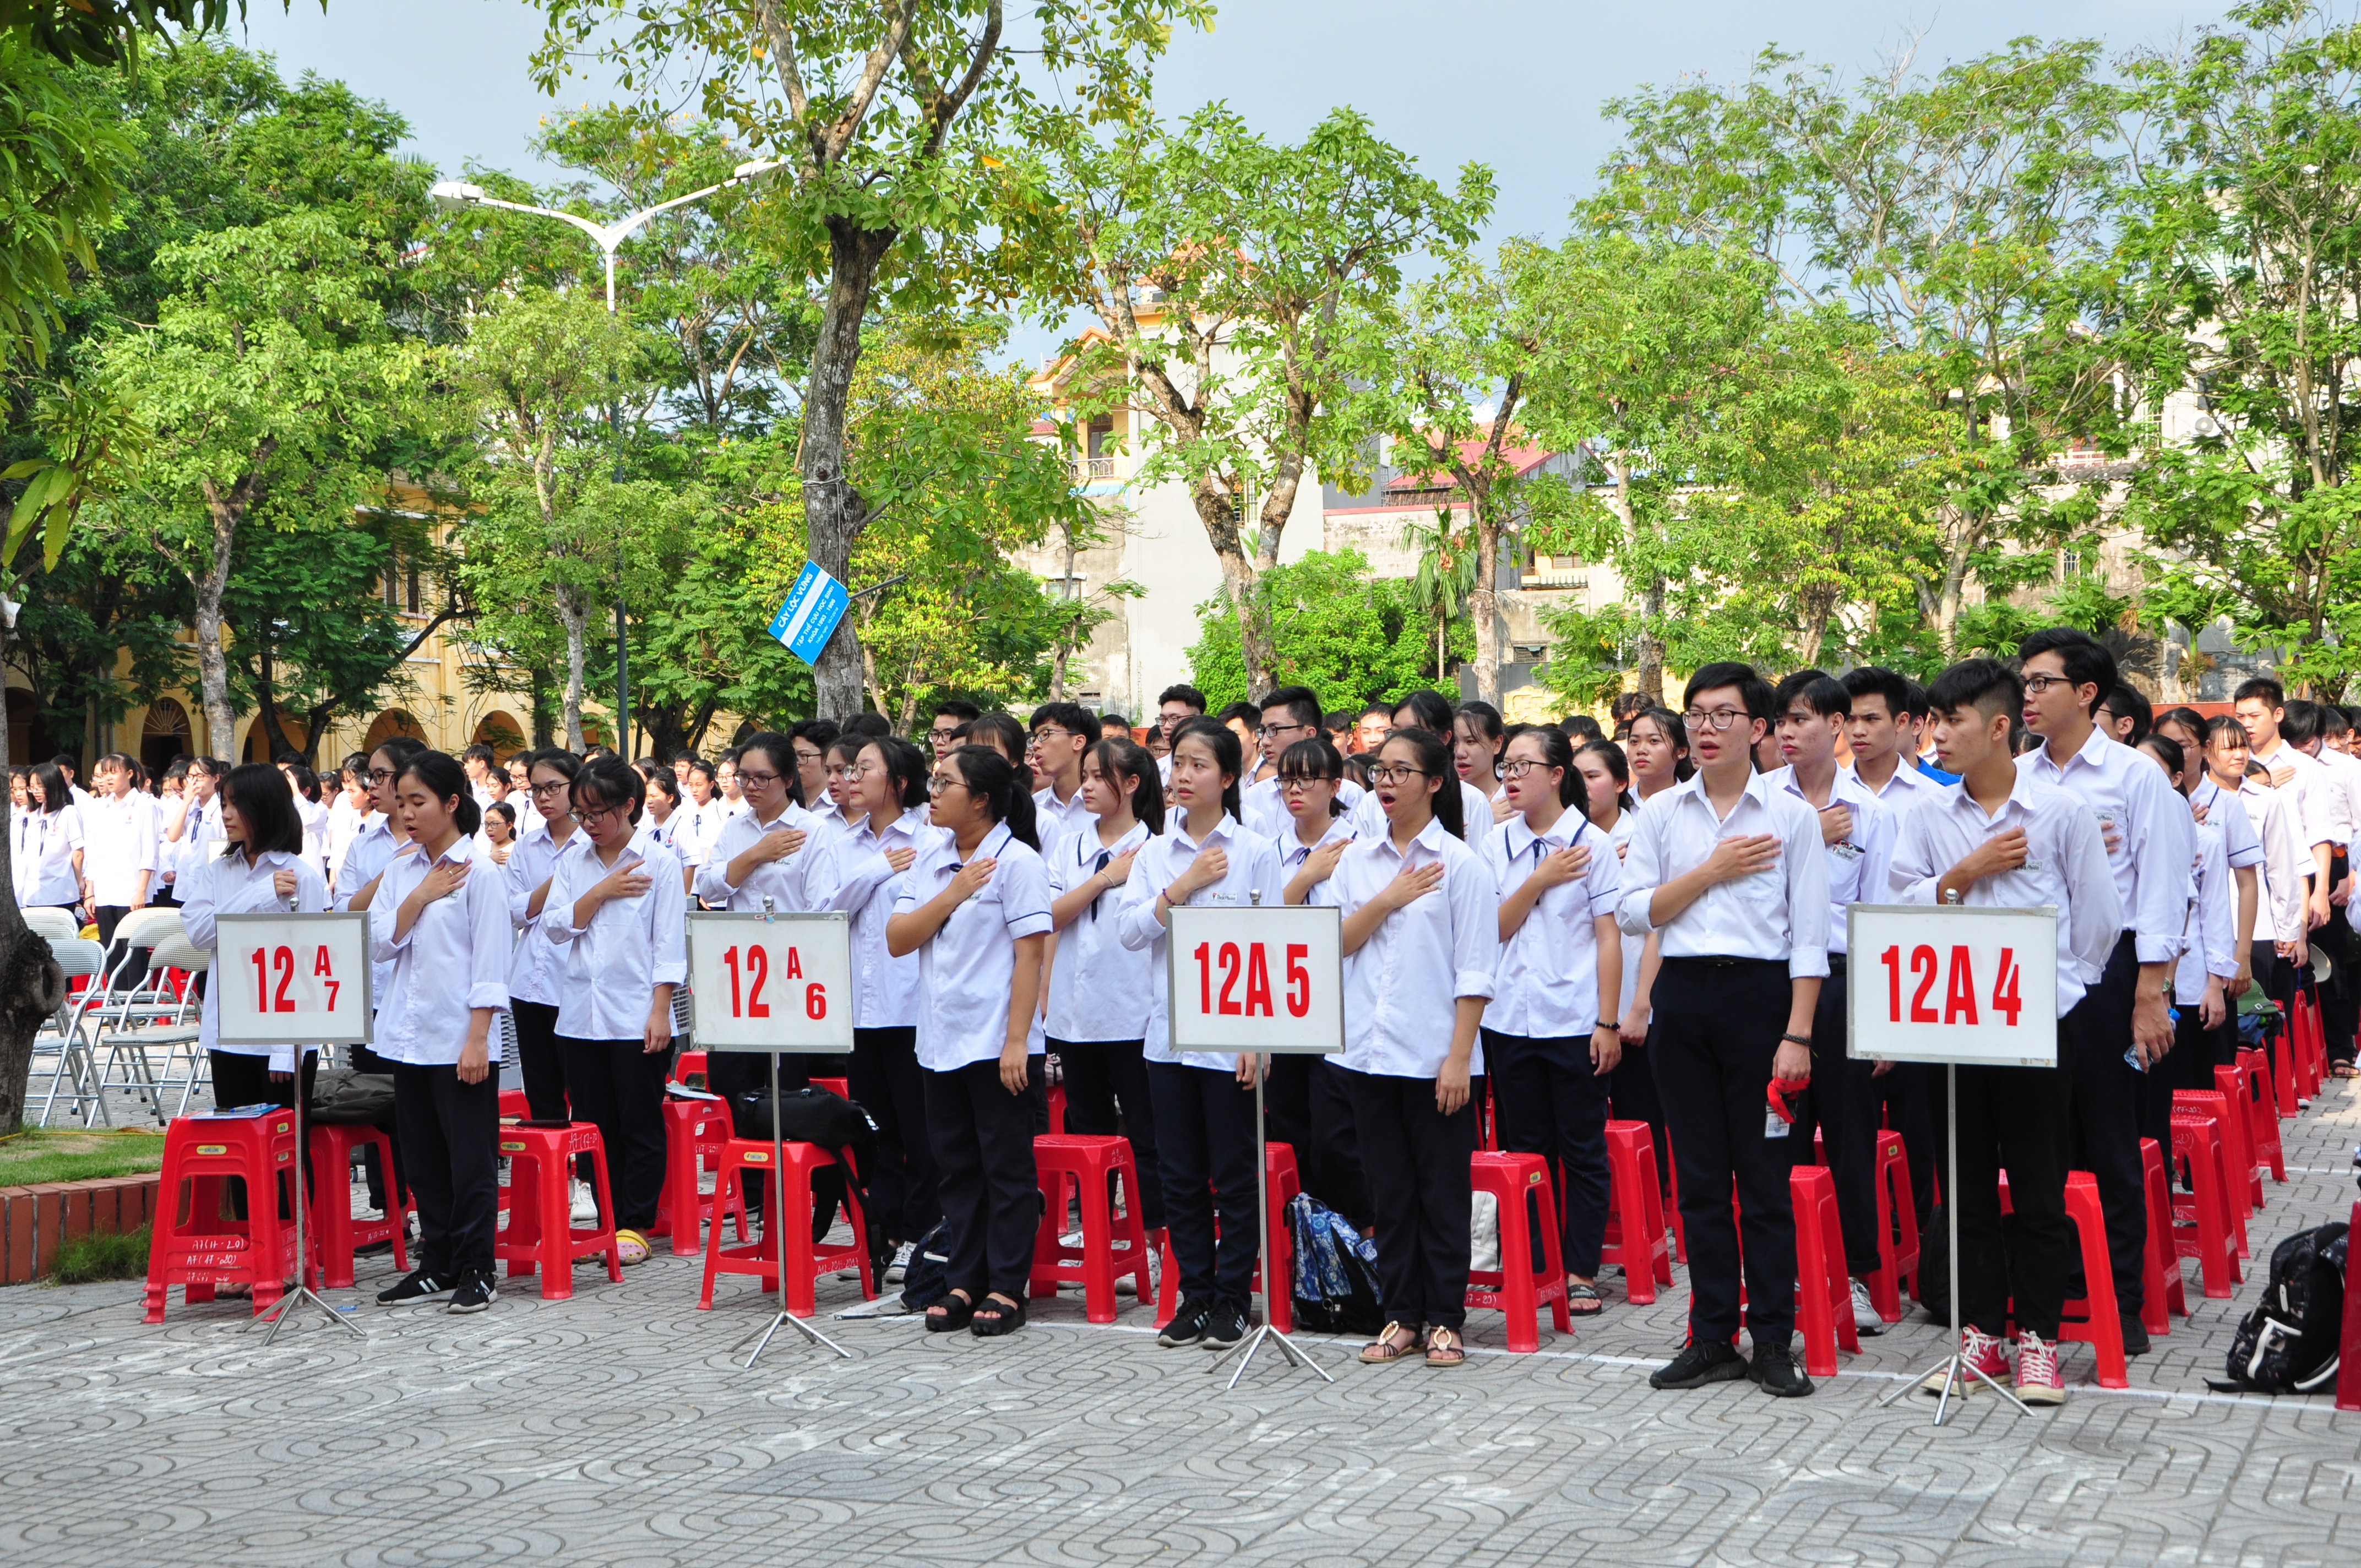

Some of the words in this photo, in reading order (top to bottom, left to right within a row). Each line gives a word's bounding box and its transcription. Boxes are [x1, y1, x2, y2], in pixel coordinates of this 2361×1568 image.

[788, 595, 801, 612] LỘC
[797, 571, 813, 595] VỪNG
[817, 598, 826, 612] HỌC
[824, 585, 835, 600] SINH
